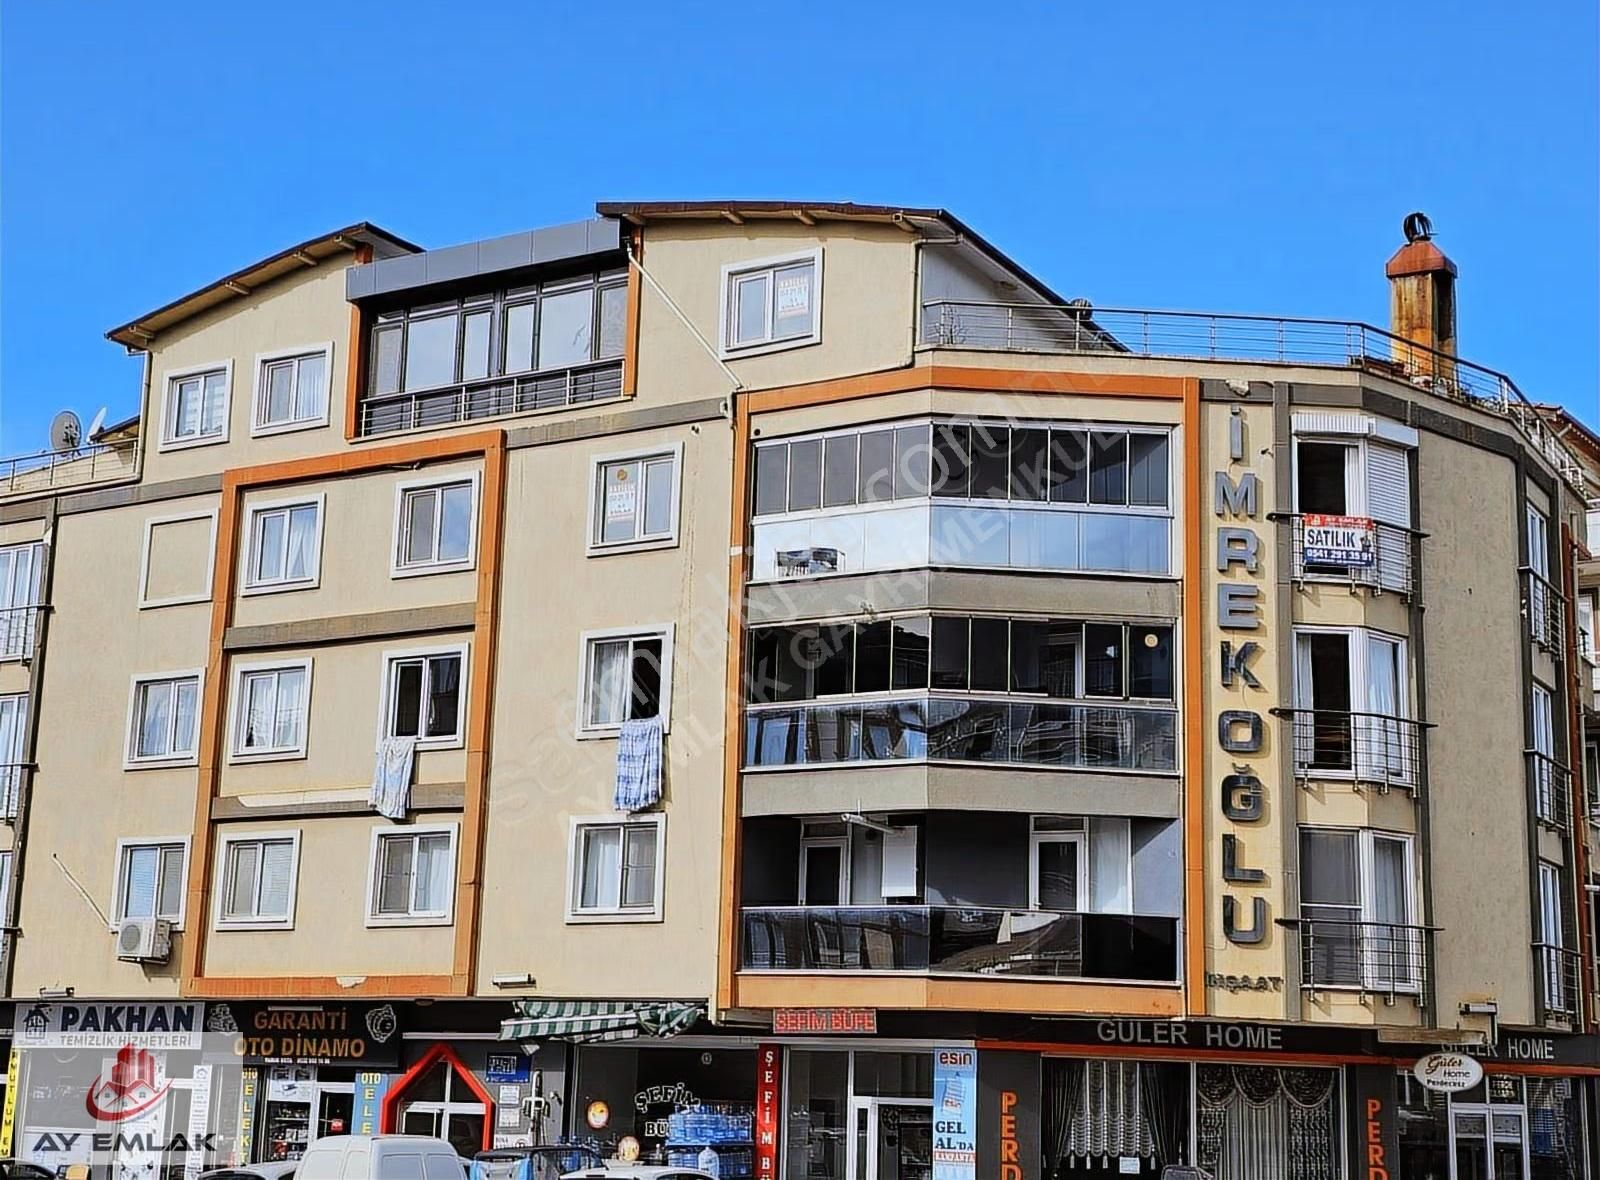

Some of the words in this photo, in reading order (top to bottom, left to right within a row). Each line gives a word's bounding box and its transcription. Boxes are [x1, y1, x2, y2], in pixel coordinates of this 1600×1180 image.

[1307, 528, 1356, 548] SATILIK
[1214, 404, 1264, 943] İMREKOĞLU
[61, 1005, 195, 1032] PAKHAN
[254, 1007, 347, 1031] GARANTİ
[60, 1033, 117, 1047] TEMİZLİK
[118, 1033, 192, 1047] HİZMETLERİ
[233, 1038, 274, 1057] OTO
[281, 1033, 365, 1058] DİNAMO
[1205, 1024, 1282, 1049] HOME
[939, 1051, 972, 1065] esin
[1508, 1038, 1554, 1060] HOME
[361, 1072, 381, 1085] OTO
[1443, 1070, 1471, 1079] Home
[761, 1050, 774, 1145] ŞEFİM
[935, 1120, 967, 1135] GEL
[935, 1137, 974, 1152] AL'DA
